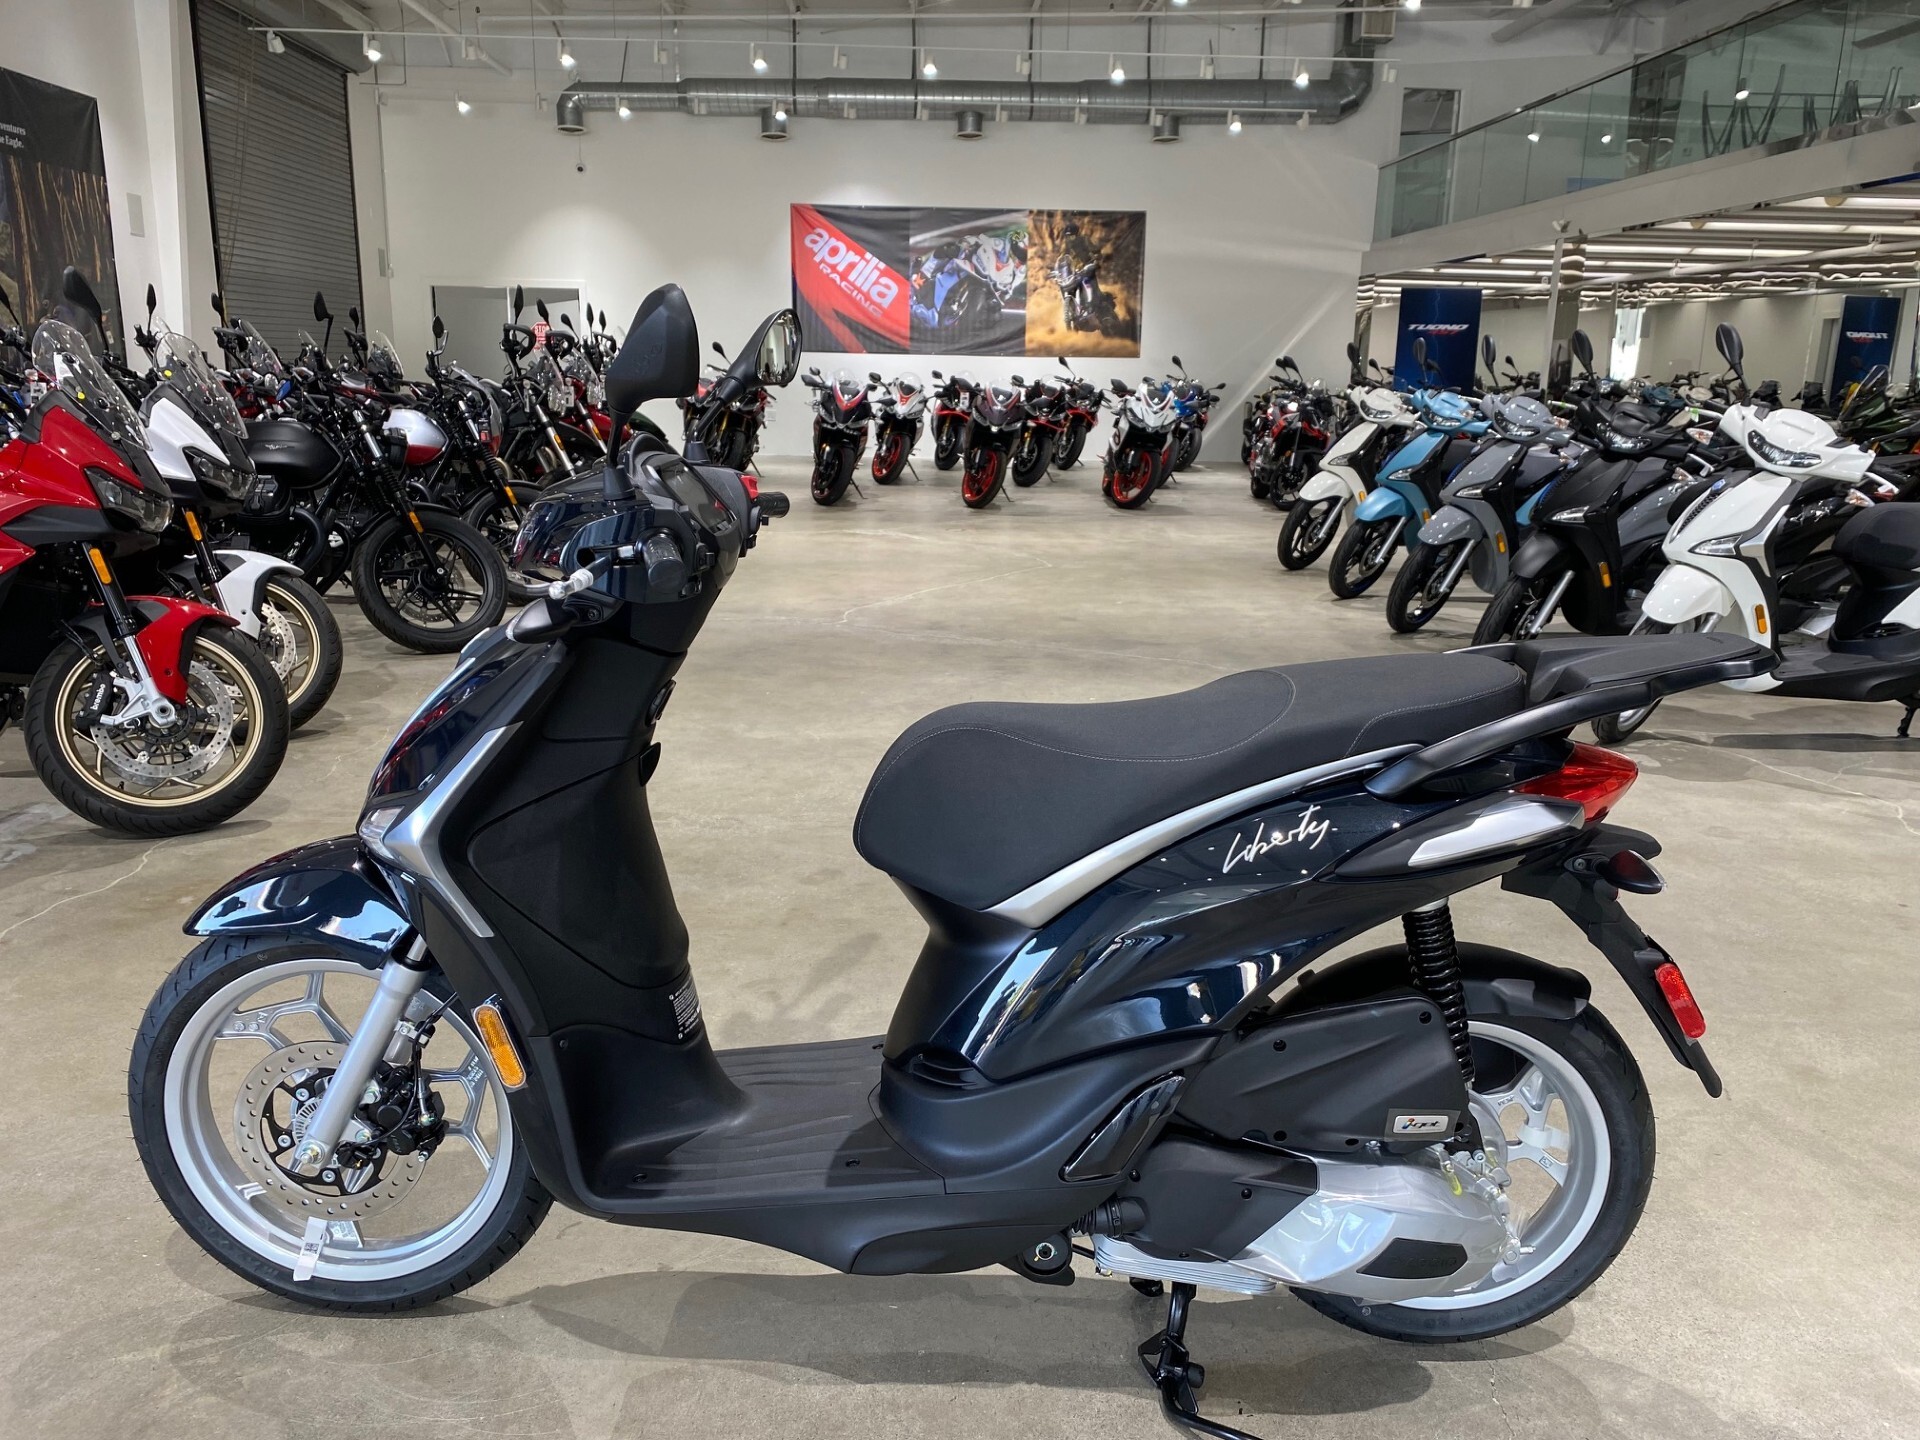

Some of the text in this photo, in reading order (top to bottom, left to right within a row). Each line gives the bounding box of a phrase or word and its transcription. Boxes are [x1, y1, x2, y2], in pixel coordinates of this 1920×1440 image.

[5, 135, 25, 148] Eagle.
[804, 227, 898, 309] aprilia
[819, 263, 883, 317] RACING
[90, 683, 105, 710] brembo
[1222, 804, 1330, 874] Liberty
